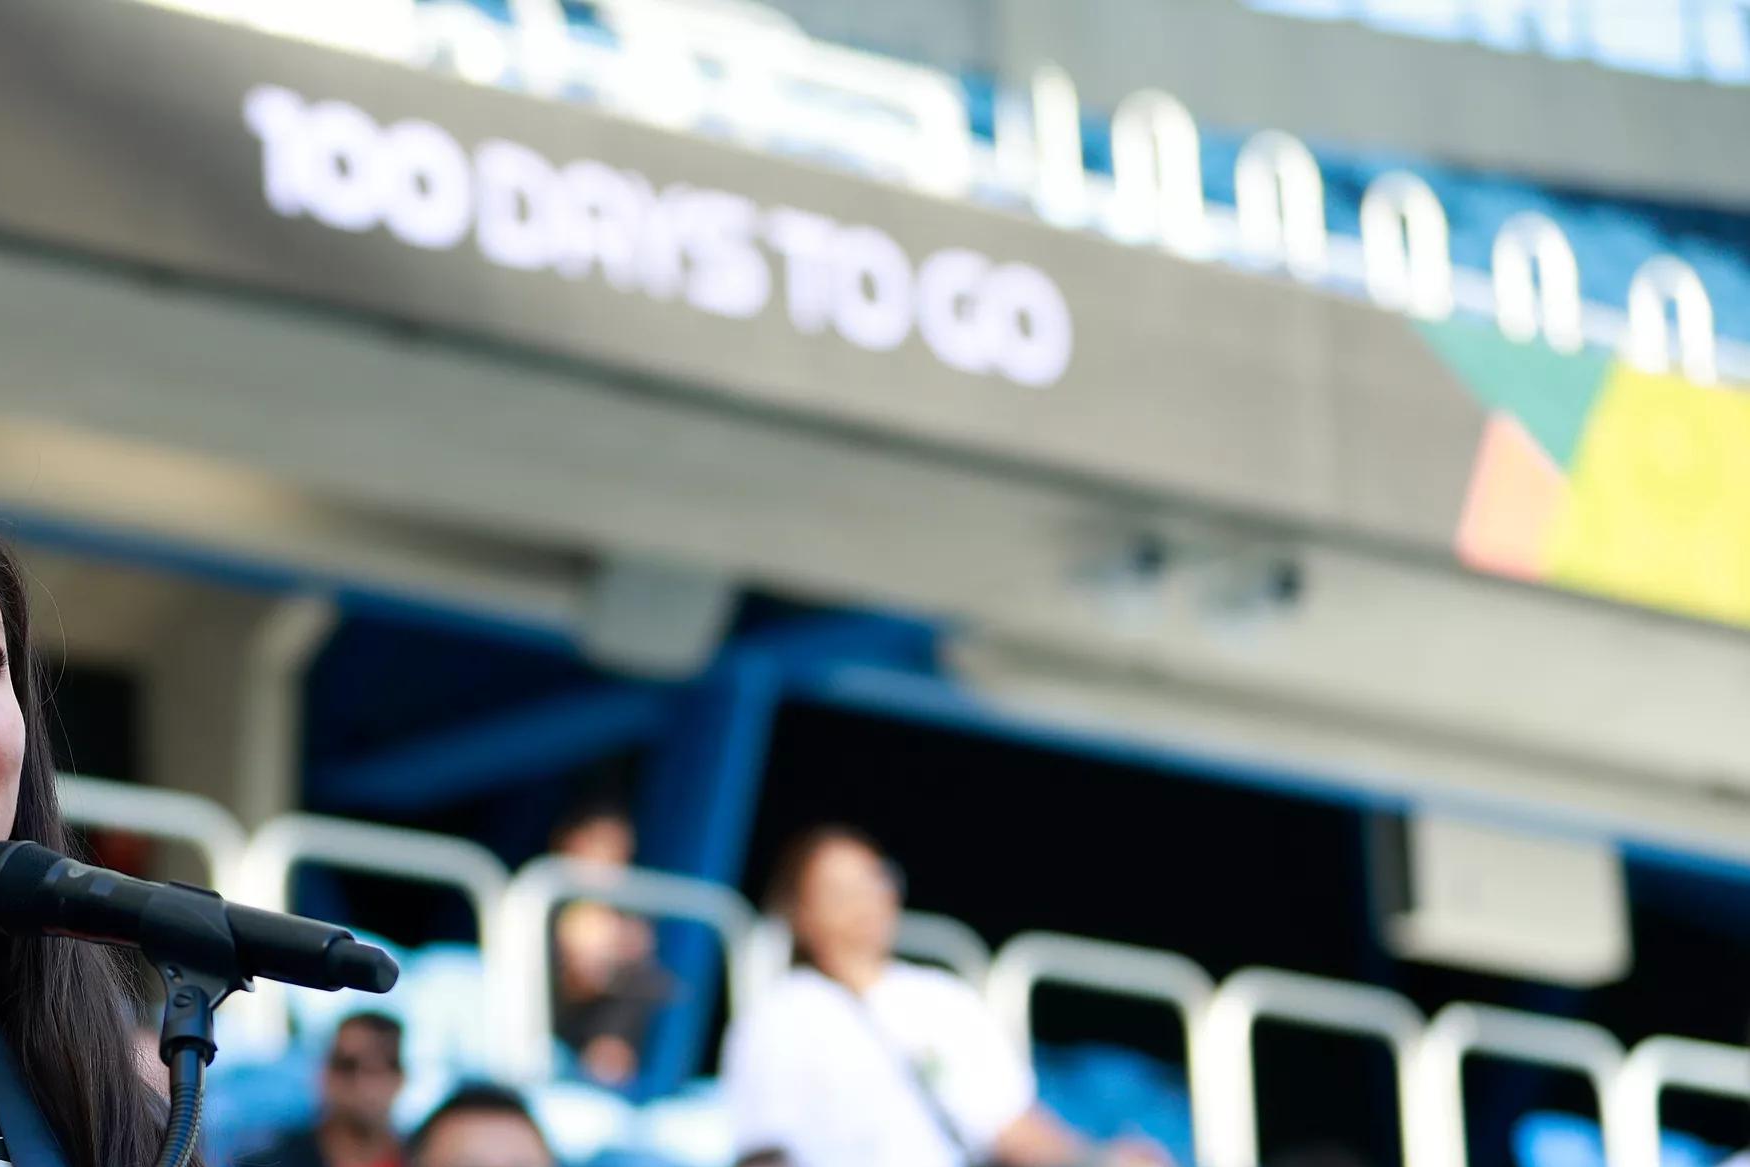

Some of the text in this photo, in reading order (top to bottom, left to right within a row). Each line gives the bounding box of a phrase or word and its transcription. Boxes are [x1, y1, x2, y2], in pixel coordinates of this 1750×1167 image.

[243, 83, 1073, 390] 100 DAYS TO GO
